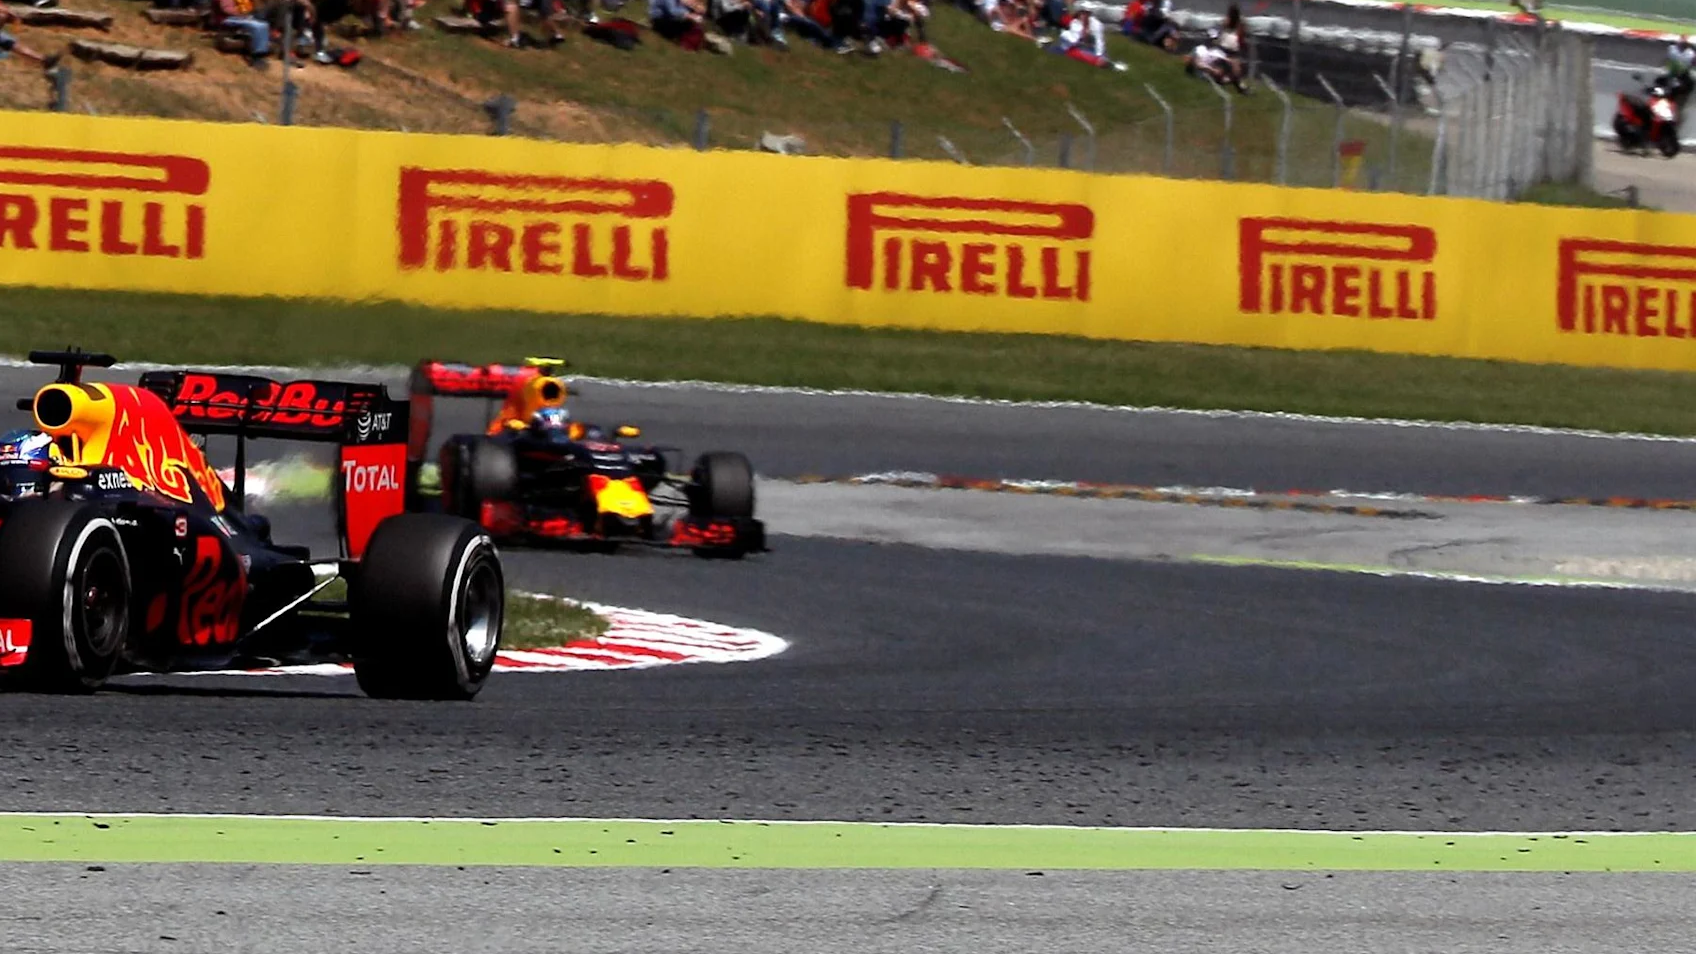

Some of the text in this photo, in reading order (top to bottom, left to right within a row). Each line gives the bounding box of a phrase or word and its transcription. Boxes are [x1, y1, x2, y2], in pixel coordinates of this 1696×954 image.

[397, 167, 674, 280] PIRELLI
[846, 192, 1094, 301] PIRELLI
[1239, 217, 1436, 320] PIRELLI
[1557, 239, 1696, 338] PIREL
[372, 412, 392, 431] AT&T
[175, 517, 188, 537] 3
